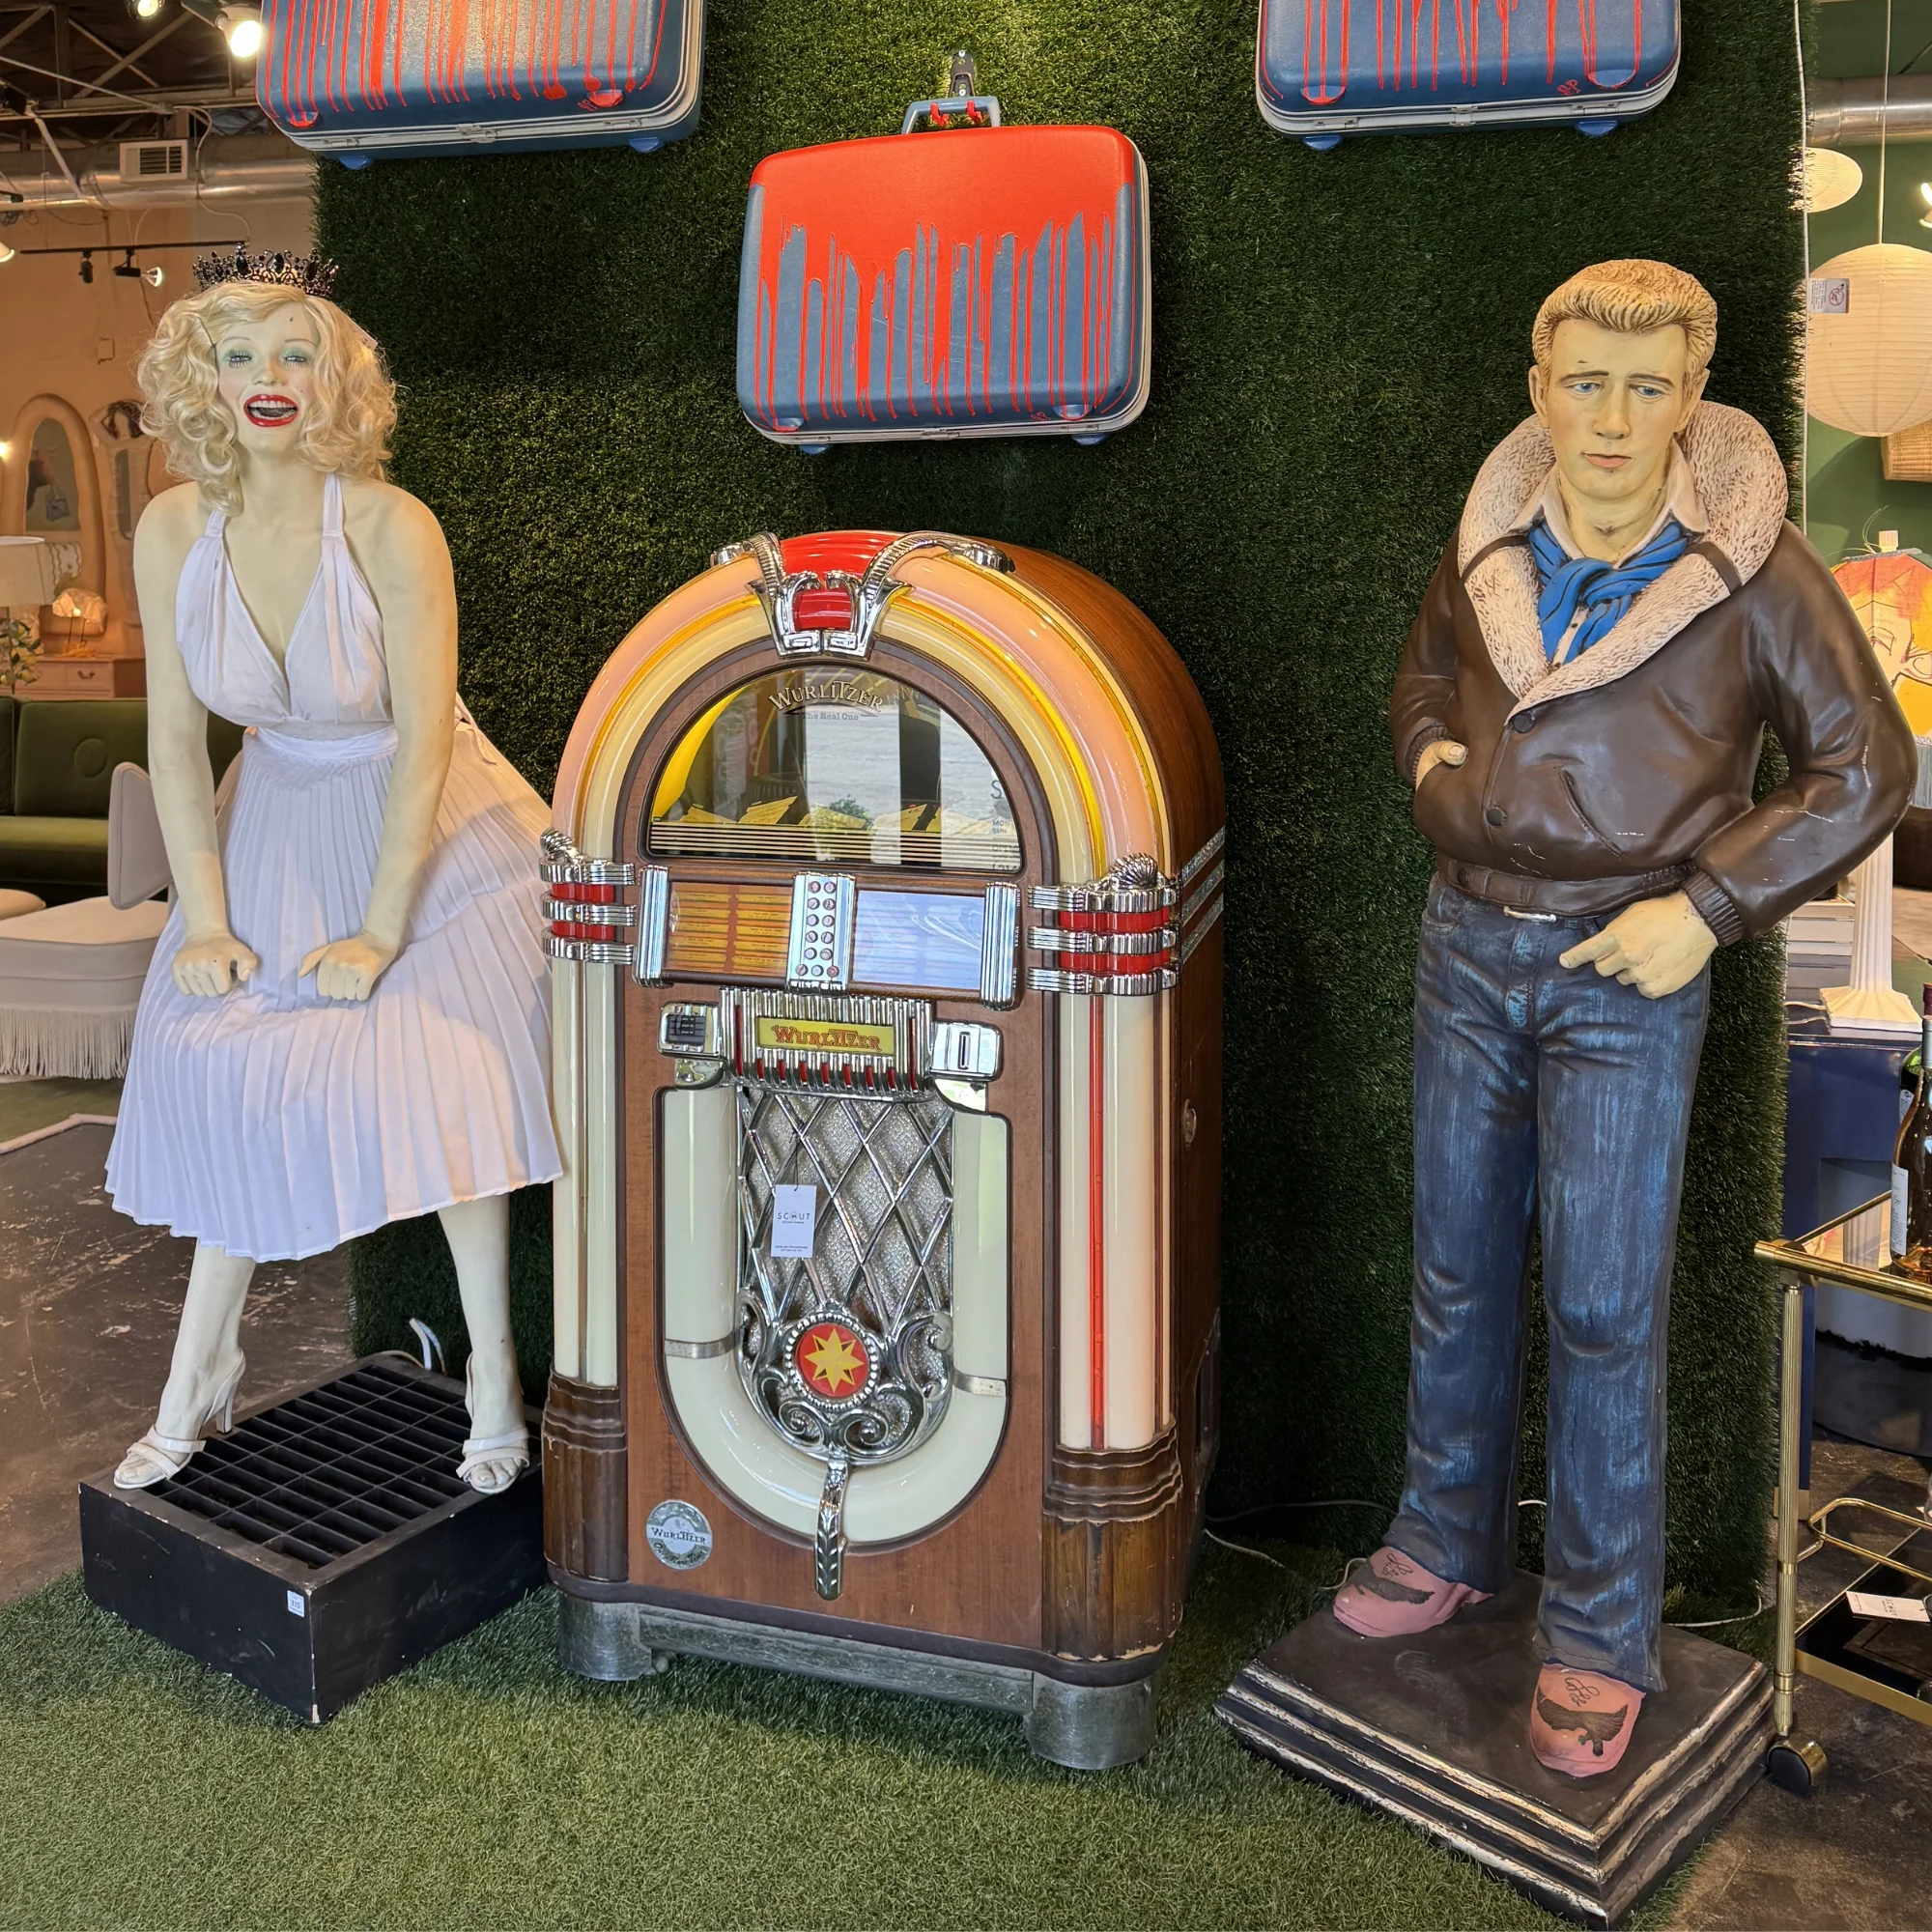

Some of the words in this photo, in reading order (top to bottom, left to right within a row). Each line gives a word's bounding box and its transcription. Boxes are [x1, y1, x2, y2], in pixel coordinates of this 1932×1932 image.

[768, 680, 884, 713] WURLITZER
[771, 1025, 882, 1052] WURLITZER
[777, 1211, 810, 1220] SCOUT
[650, 1527, 706, 1546] WURLITZER
